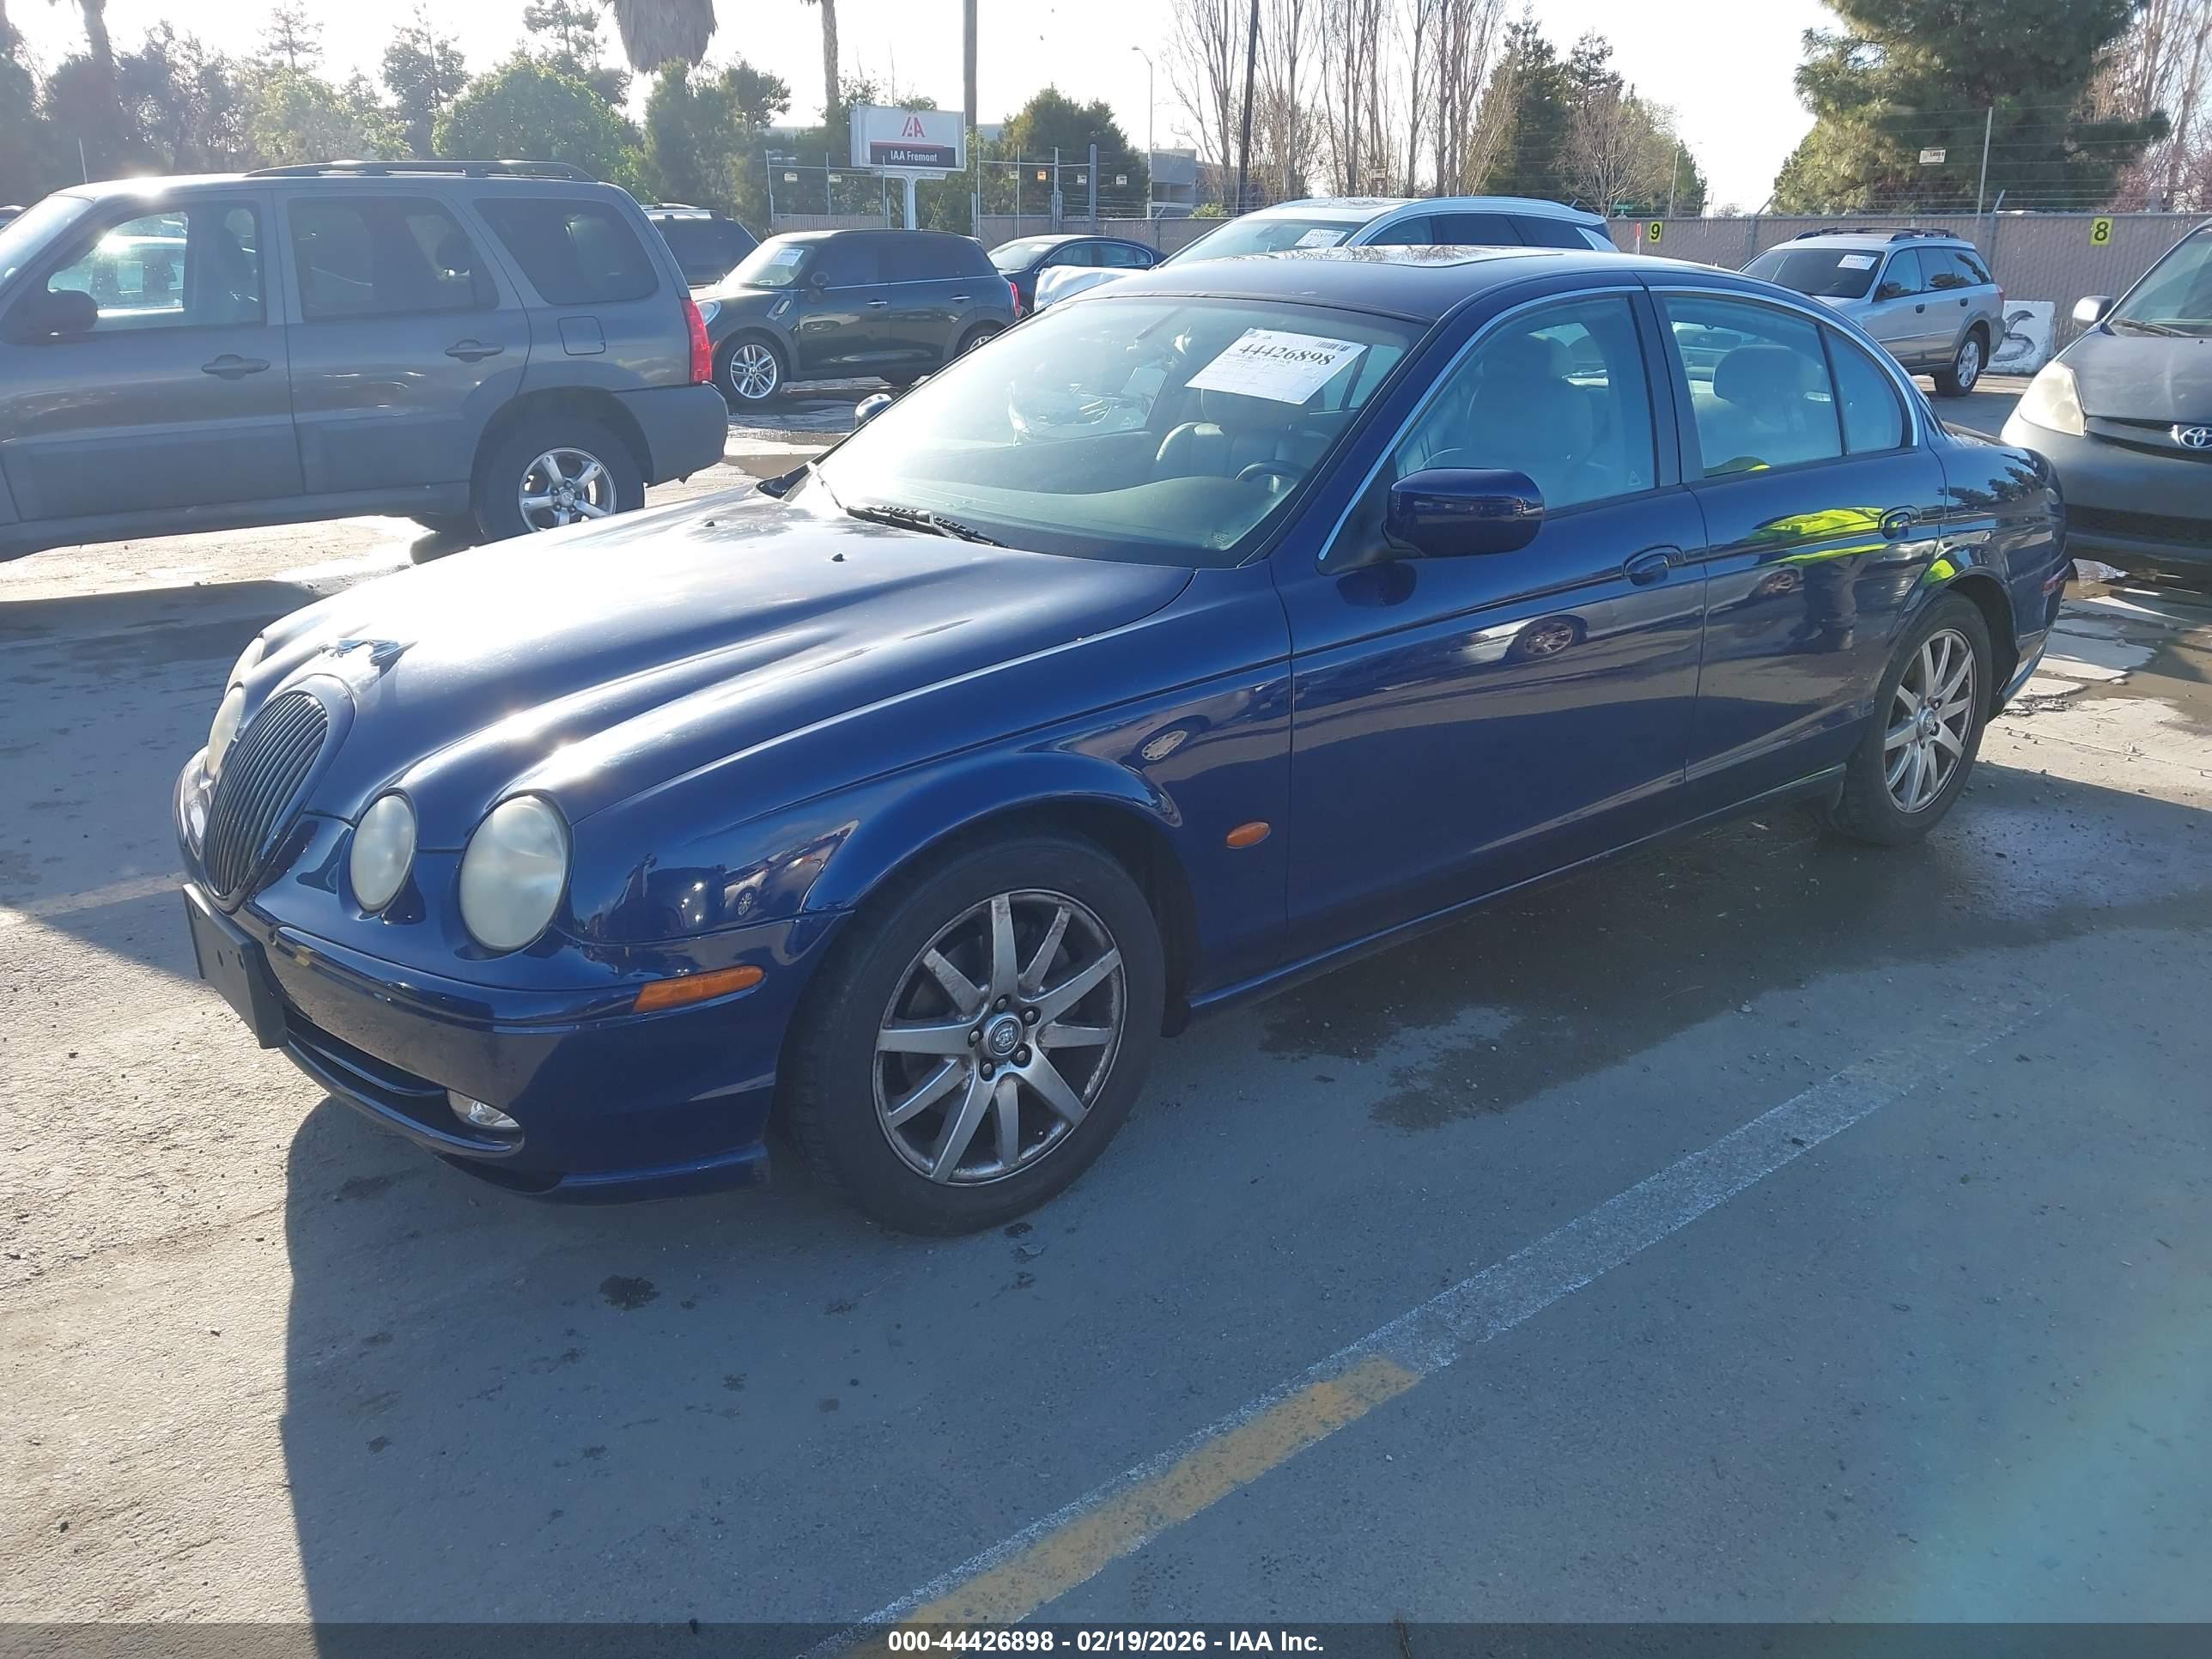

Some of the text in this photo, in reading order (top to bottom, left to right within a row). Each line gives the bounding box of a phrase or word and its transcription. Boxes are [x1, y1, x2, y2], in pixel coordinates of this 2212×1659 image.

[890, 150, 937, 162] IAA Fremont
[1650, 223, 1660, 240] 9
[2094, 221, 2109, 241] 8
[1239, 343, 1335, 366] 44426898
